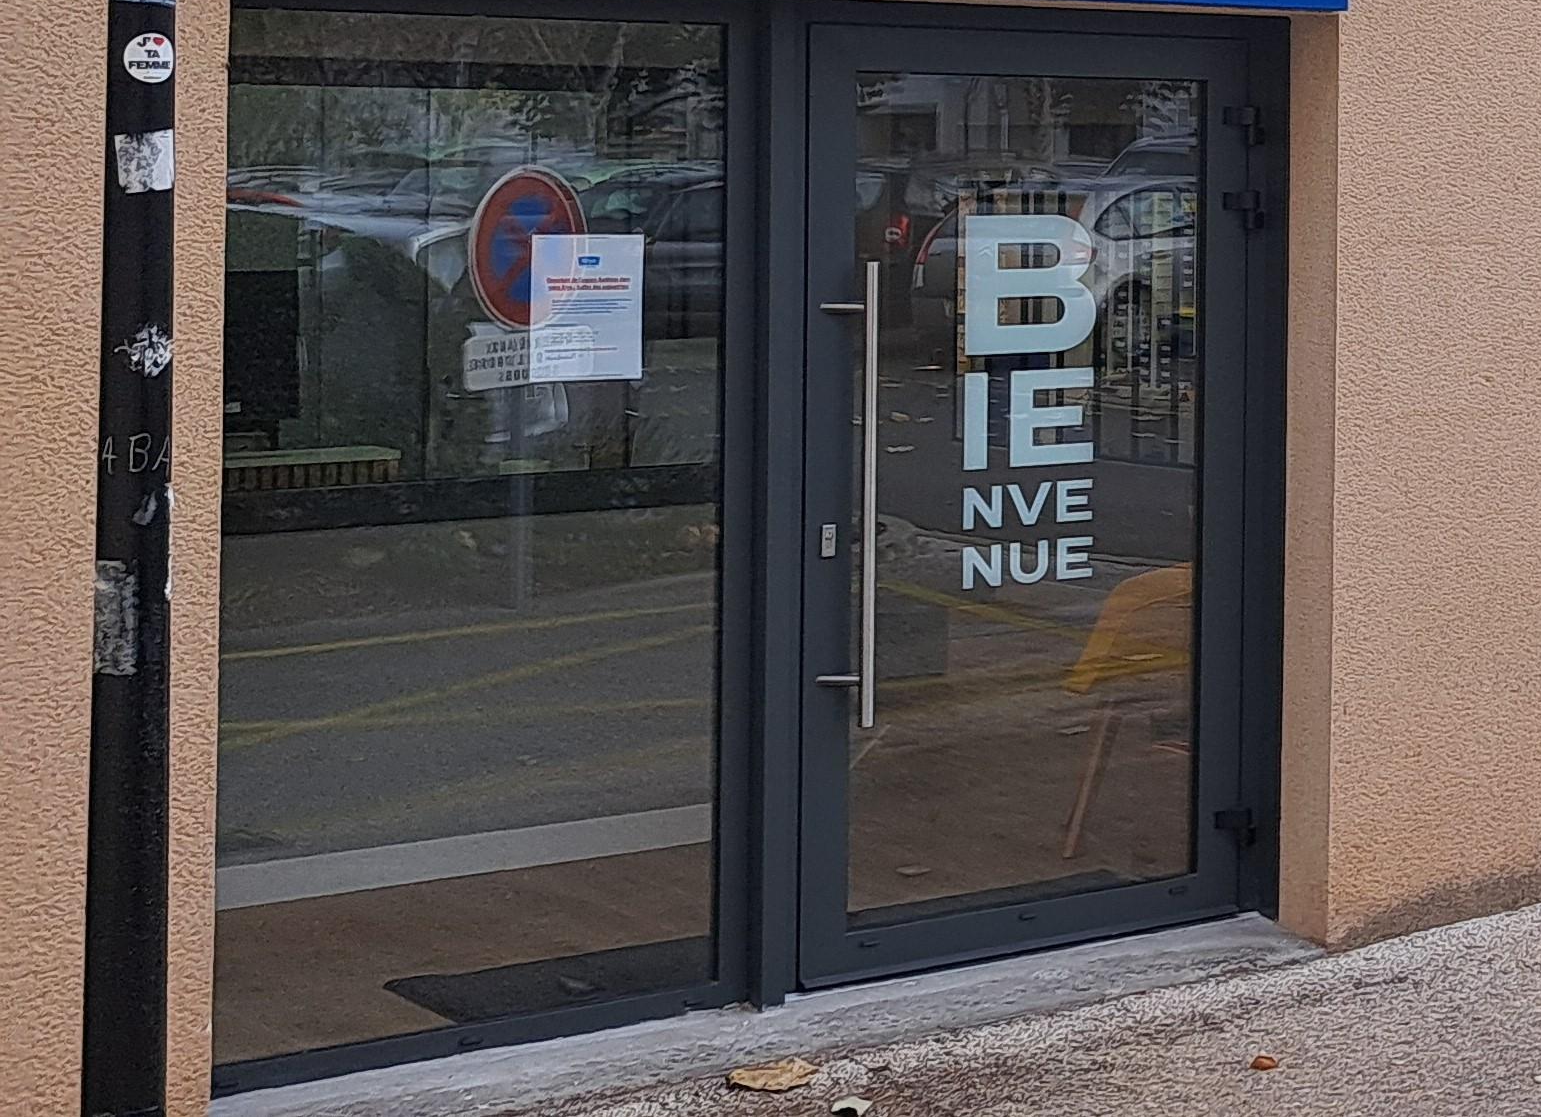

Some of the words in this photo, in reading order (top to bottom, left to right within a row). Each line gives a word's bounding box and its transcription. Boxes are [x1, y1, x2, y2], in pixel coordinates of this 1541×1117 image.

[128, 60, 171, 70] FEMME
[144, 49, 161, 59] TA
[963, 367, 1095, 471] IE
[962, 479, 1094, 530] NVE
[962, 536, 1094, 590] NUE
